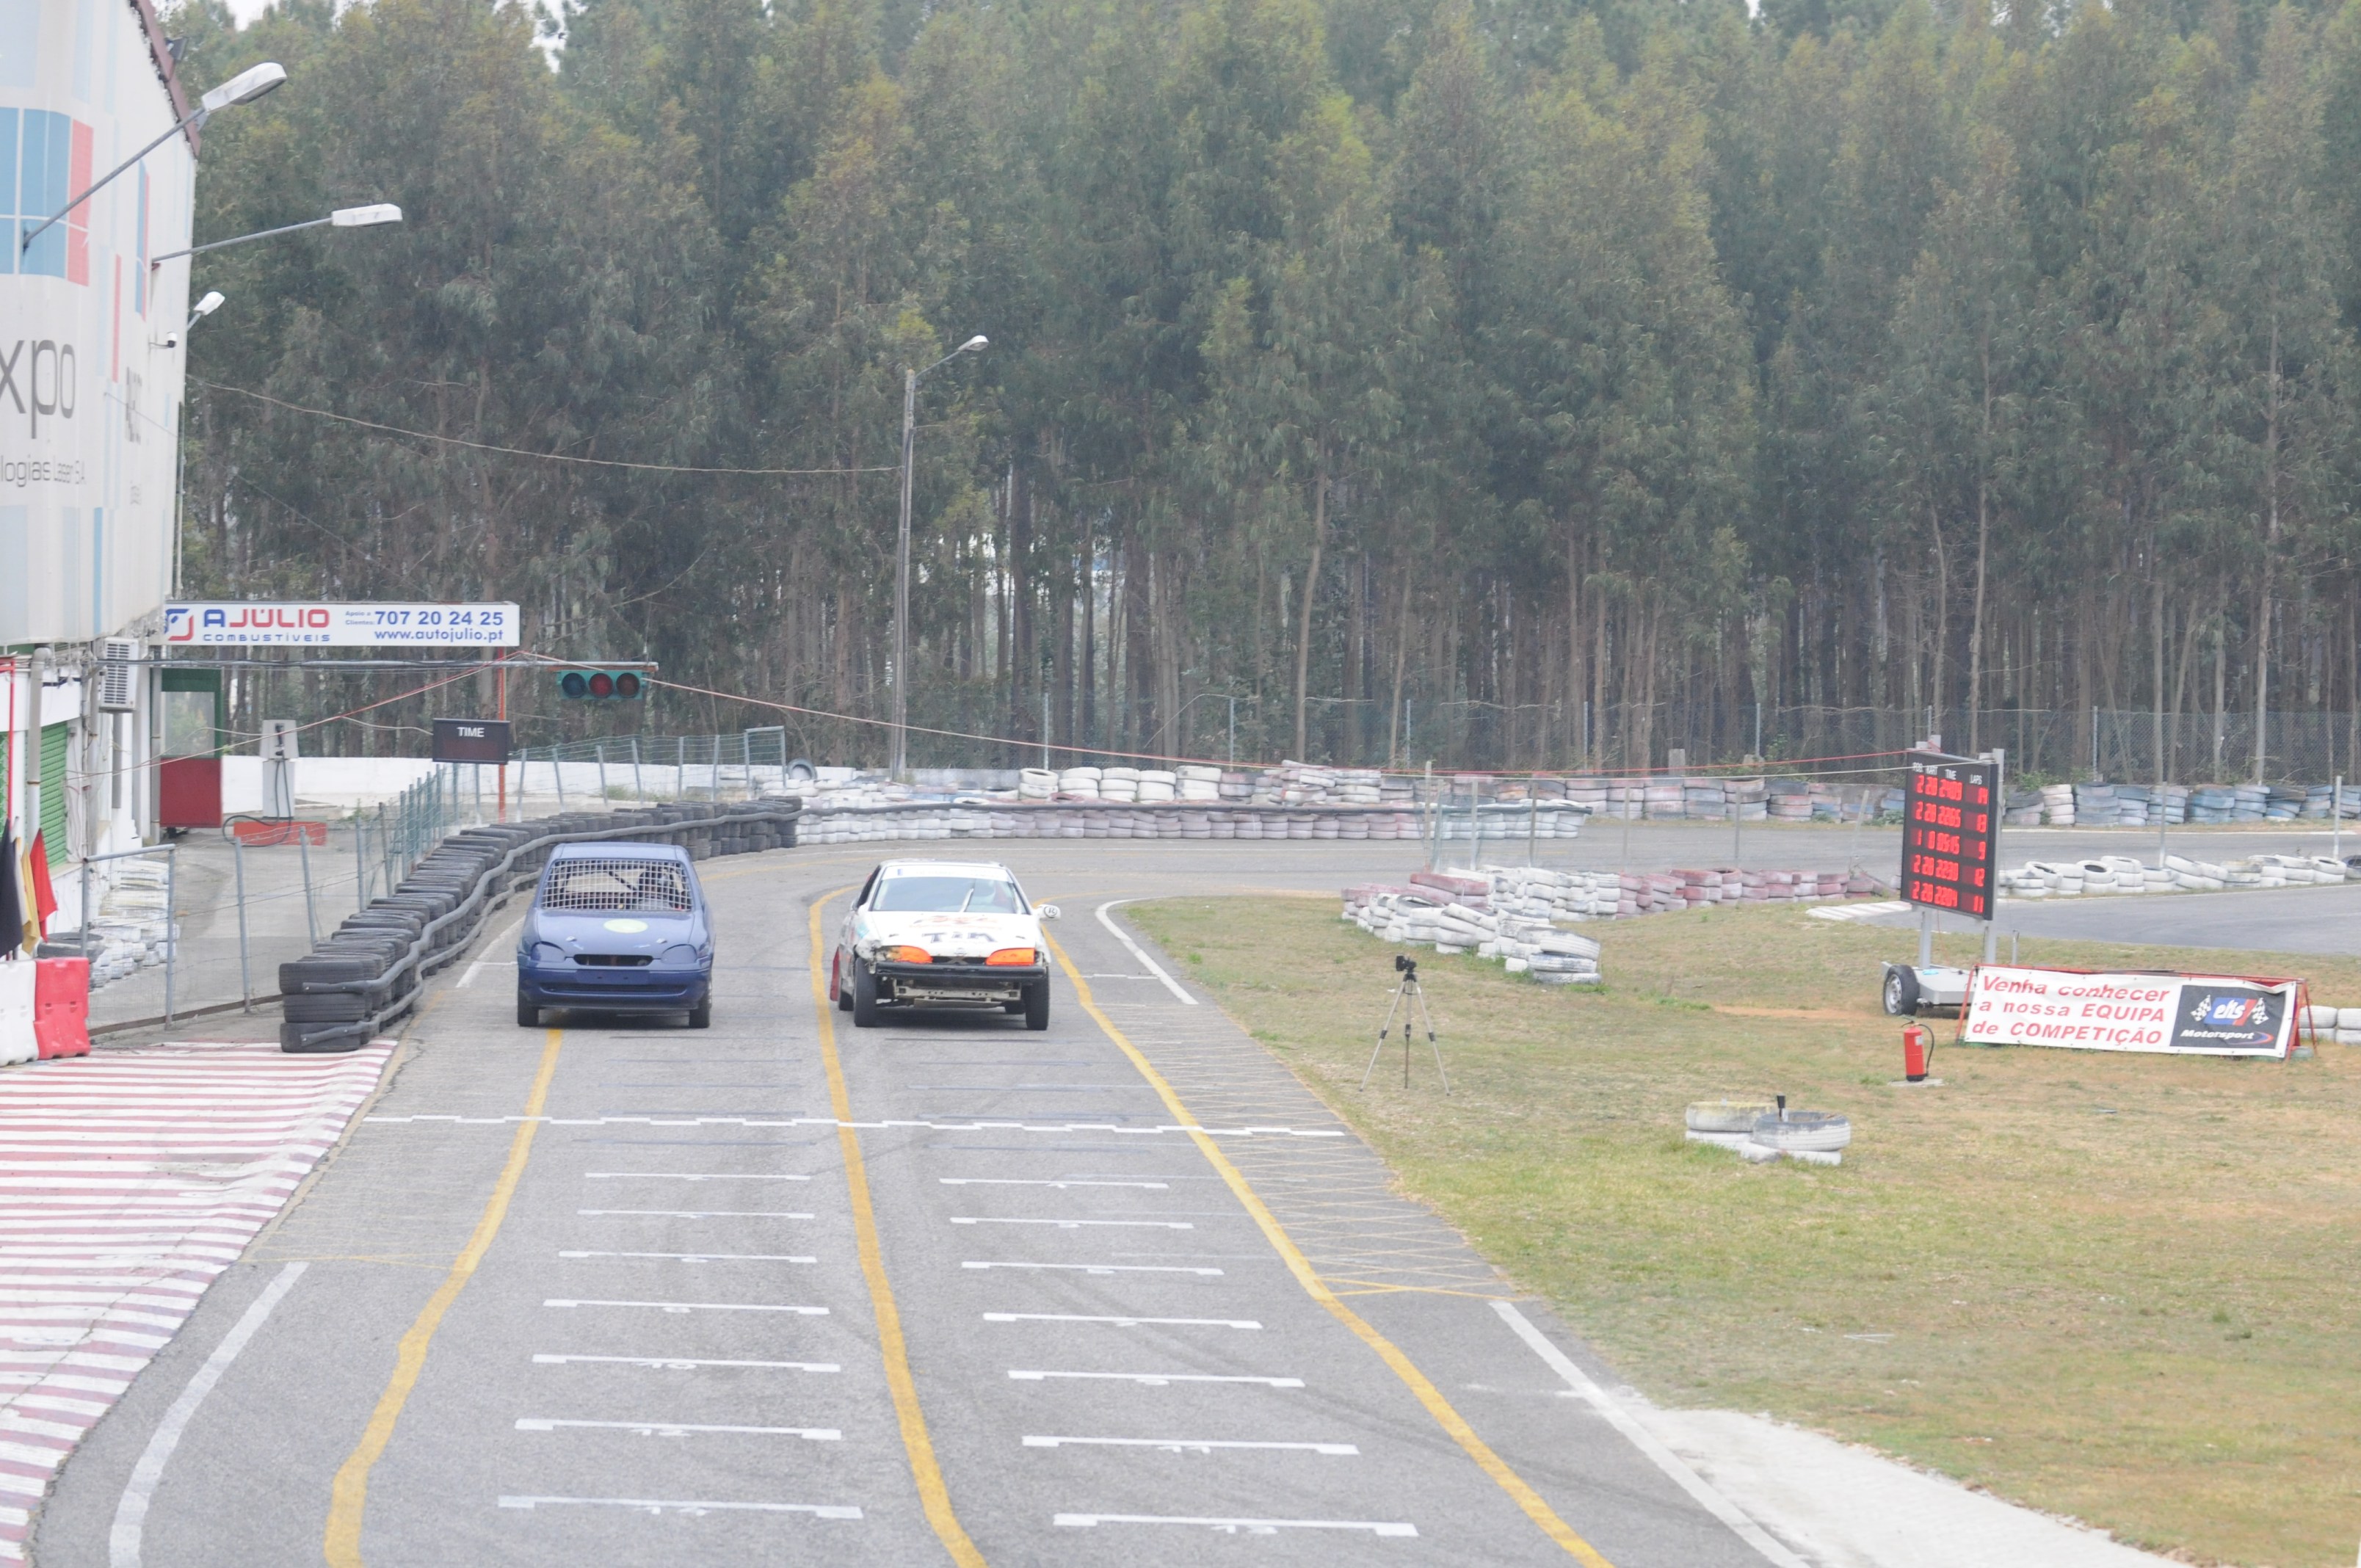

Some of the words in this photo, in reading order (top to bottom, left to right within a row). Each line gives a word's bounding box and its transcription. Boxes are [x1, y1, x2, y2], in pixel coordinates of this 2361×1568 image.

[375, 611, 410, 625] 707
[418, 611, 441, 625] 20
[449, 611, 472, 625] 24
[479, 611, 504, 625] 25
[374, 628, 504, 643] www.autojulio.pt
[457, 726, 485, 738] TIME
[1983, 976, 2048, 995] Venha
[2058, 984, 2171, 1002] conhecer
[1979, 1001, 1992, 1012] a
[2003, 1001, 2070, 1017] nossa
[2081, 1003, 2164, 1022] EQUIPA
[1972, 1021, 1999, 1035] de
[2010, 1021, 2162, 1046] COMPETIÇÃO
[2180, 1029, 2255, 1040] Motorsport
